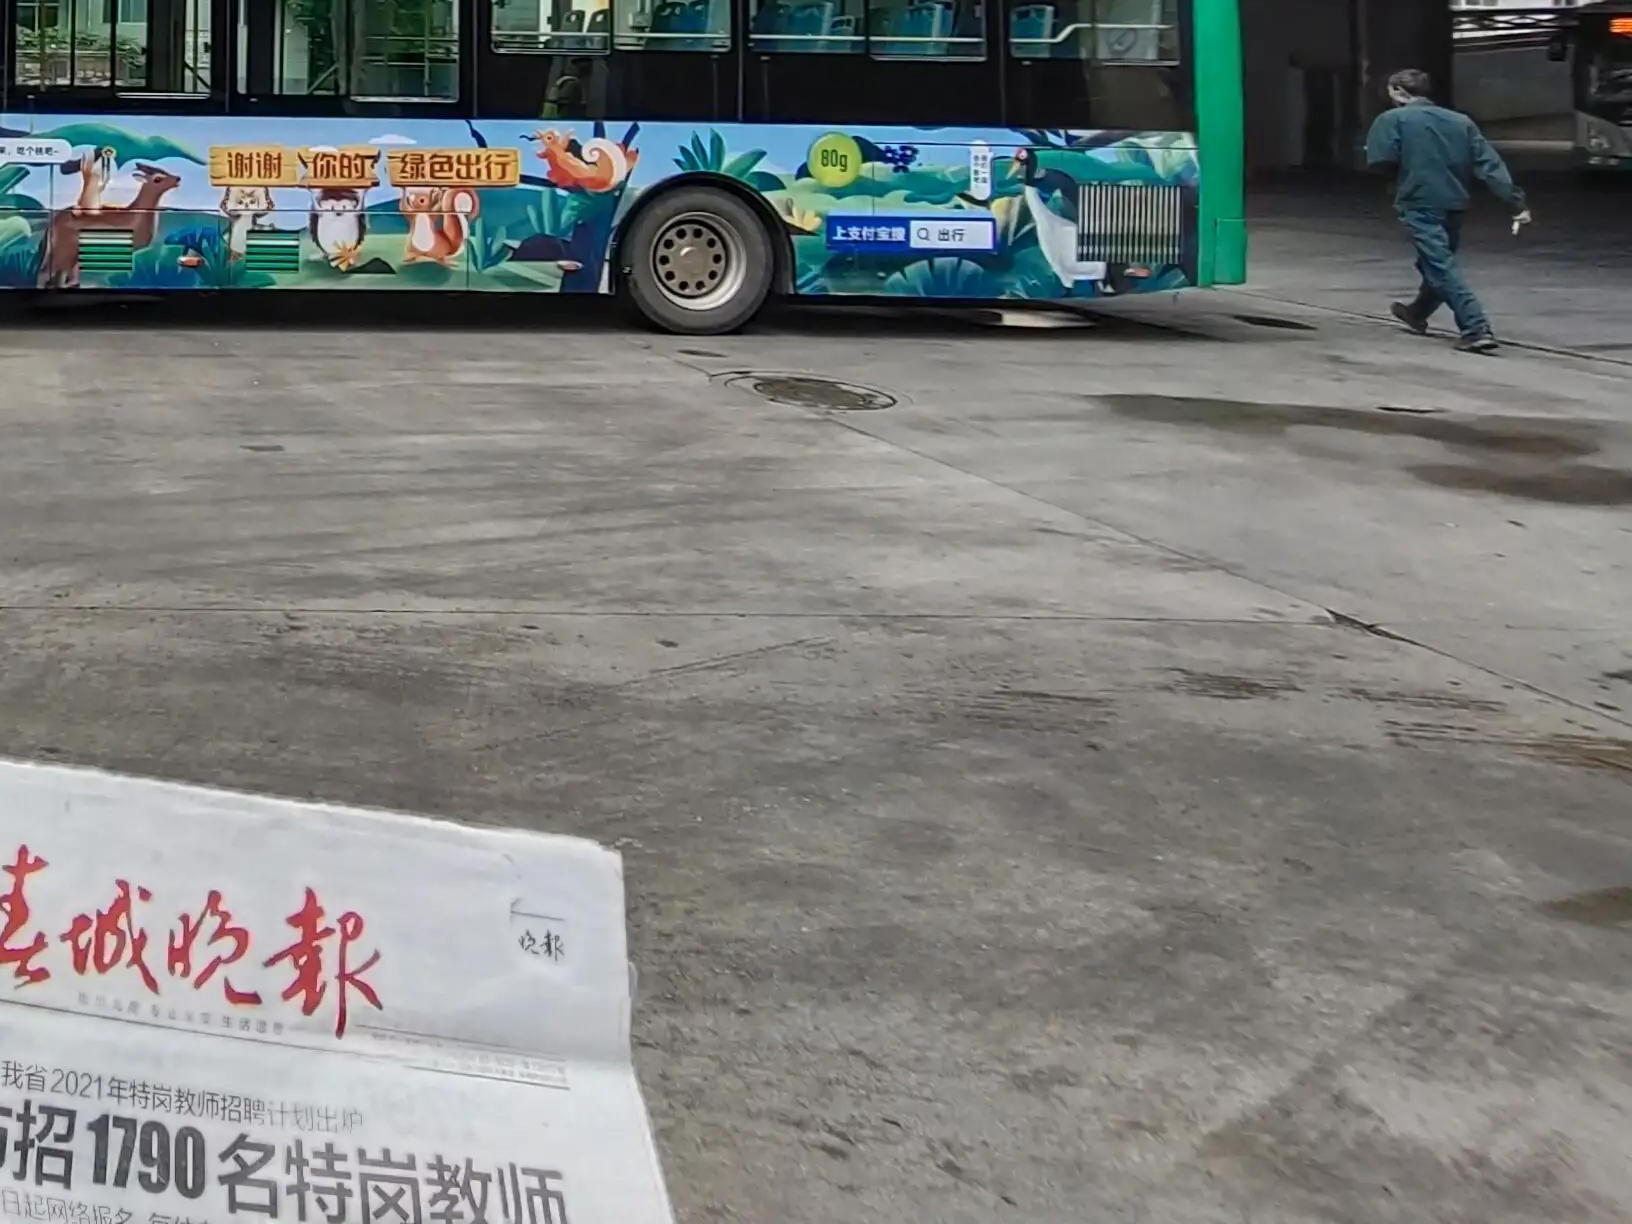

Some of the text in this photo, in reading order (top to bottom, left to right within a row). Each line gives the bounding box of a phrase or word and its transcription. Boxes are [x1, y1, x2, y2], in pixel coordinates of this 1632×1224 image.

[227, 151, 510, 180] 谢谢 你的 绿色出行
[820, 149, 848, 173] 80g
[832, 226, 966, 242] 上支付宝搜 出行
[1, 1060, 364, 1134] 我省2021年特岗教师招聘计划出炉
